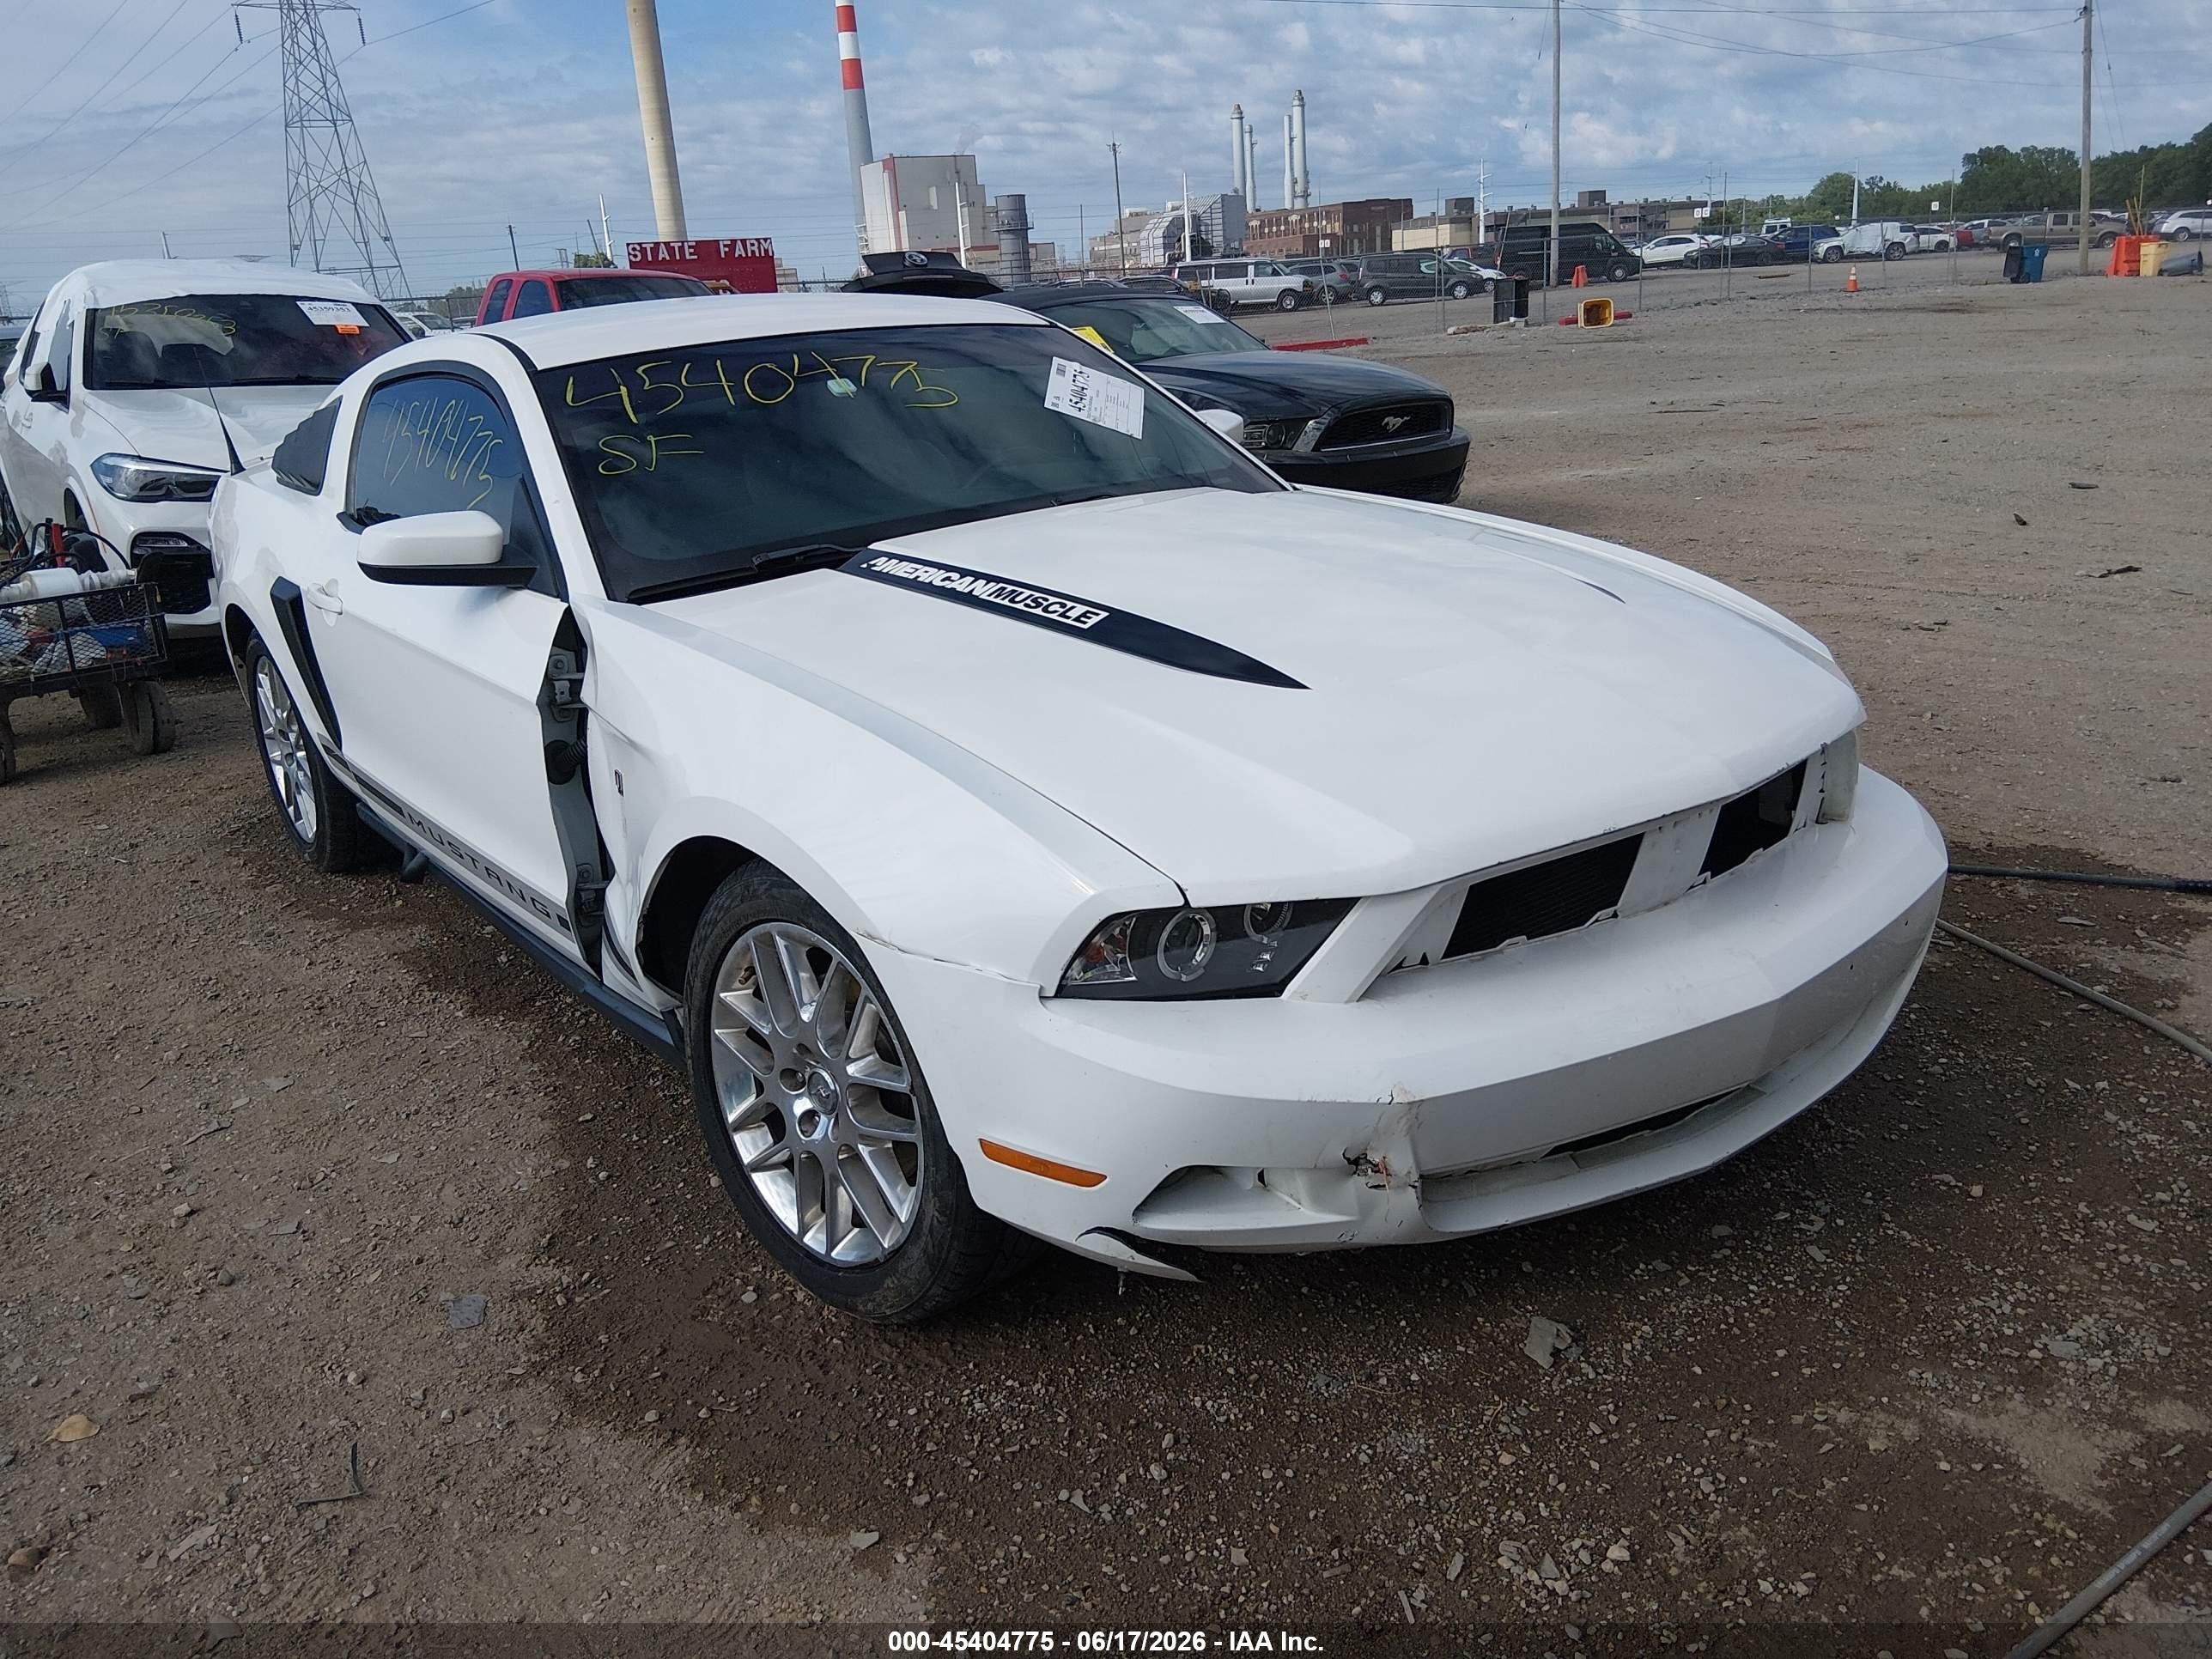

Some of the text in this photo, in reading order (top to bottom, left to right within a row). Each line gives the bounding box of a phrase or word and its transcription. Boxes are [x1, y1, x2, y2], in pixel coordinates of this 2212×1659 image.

[628, 239, 774, 262] STATE FARM
[564, 350, 960, 424] 45404775
[1068, 368, 1091, 413] 45404775
[598, 434, 705, 474] SF
[408, 812, 553, 919] MUSTANG
